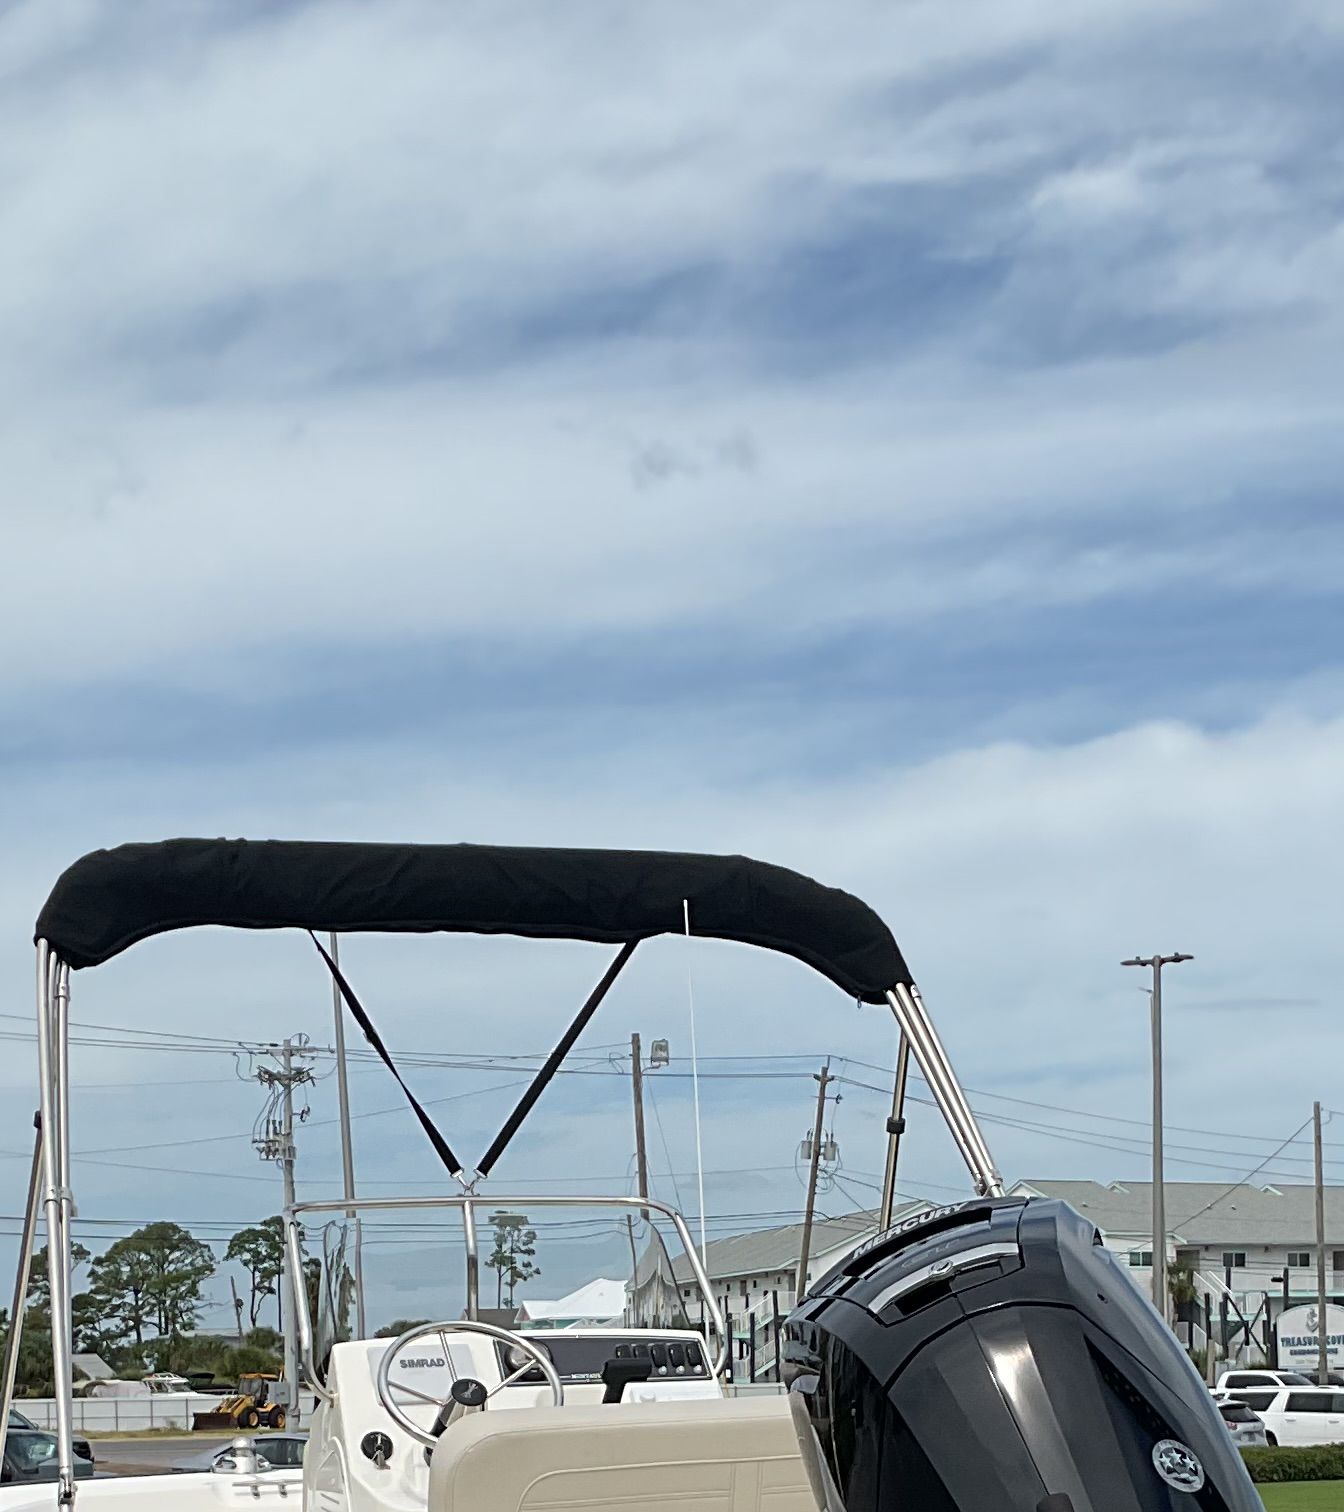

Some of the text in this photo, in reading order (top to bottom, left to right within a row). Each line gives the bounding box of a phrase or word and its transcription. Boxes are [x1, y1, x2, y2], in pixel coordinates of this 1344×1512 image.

[852, 1202, 968, 1260] MERCURY
[1281, 1336, 1320, 1347] TREASUR
[399, 1358, 445, 1369] SIMRAD
